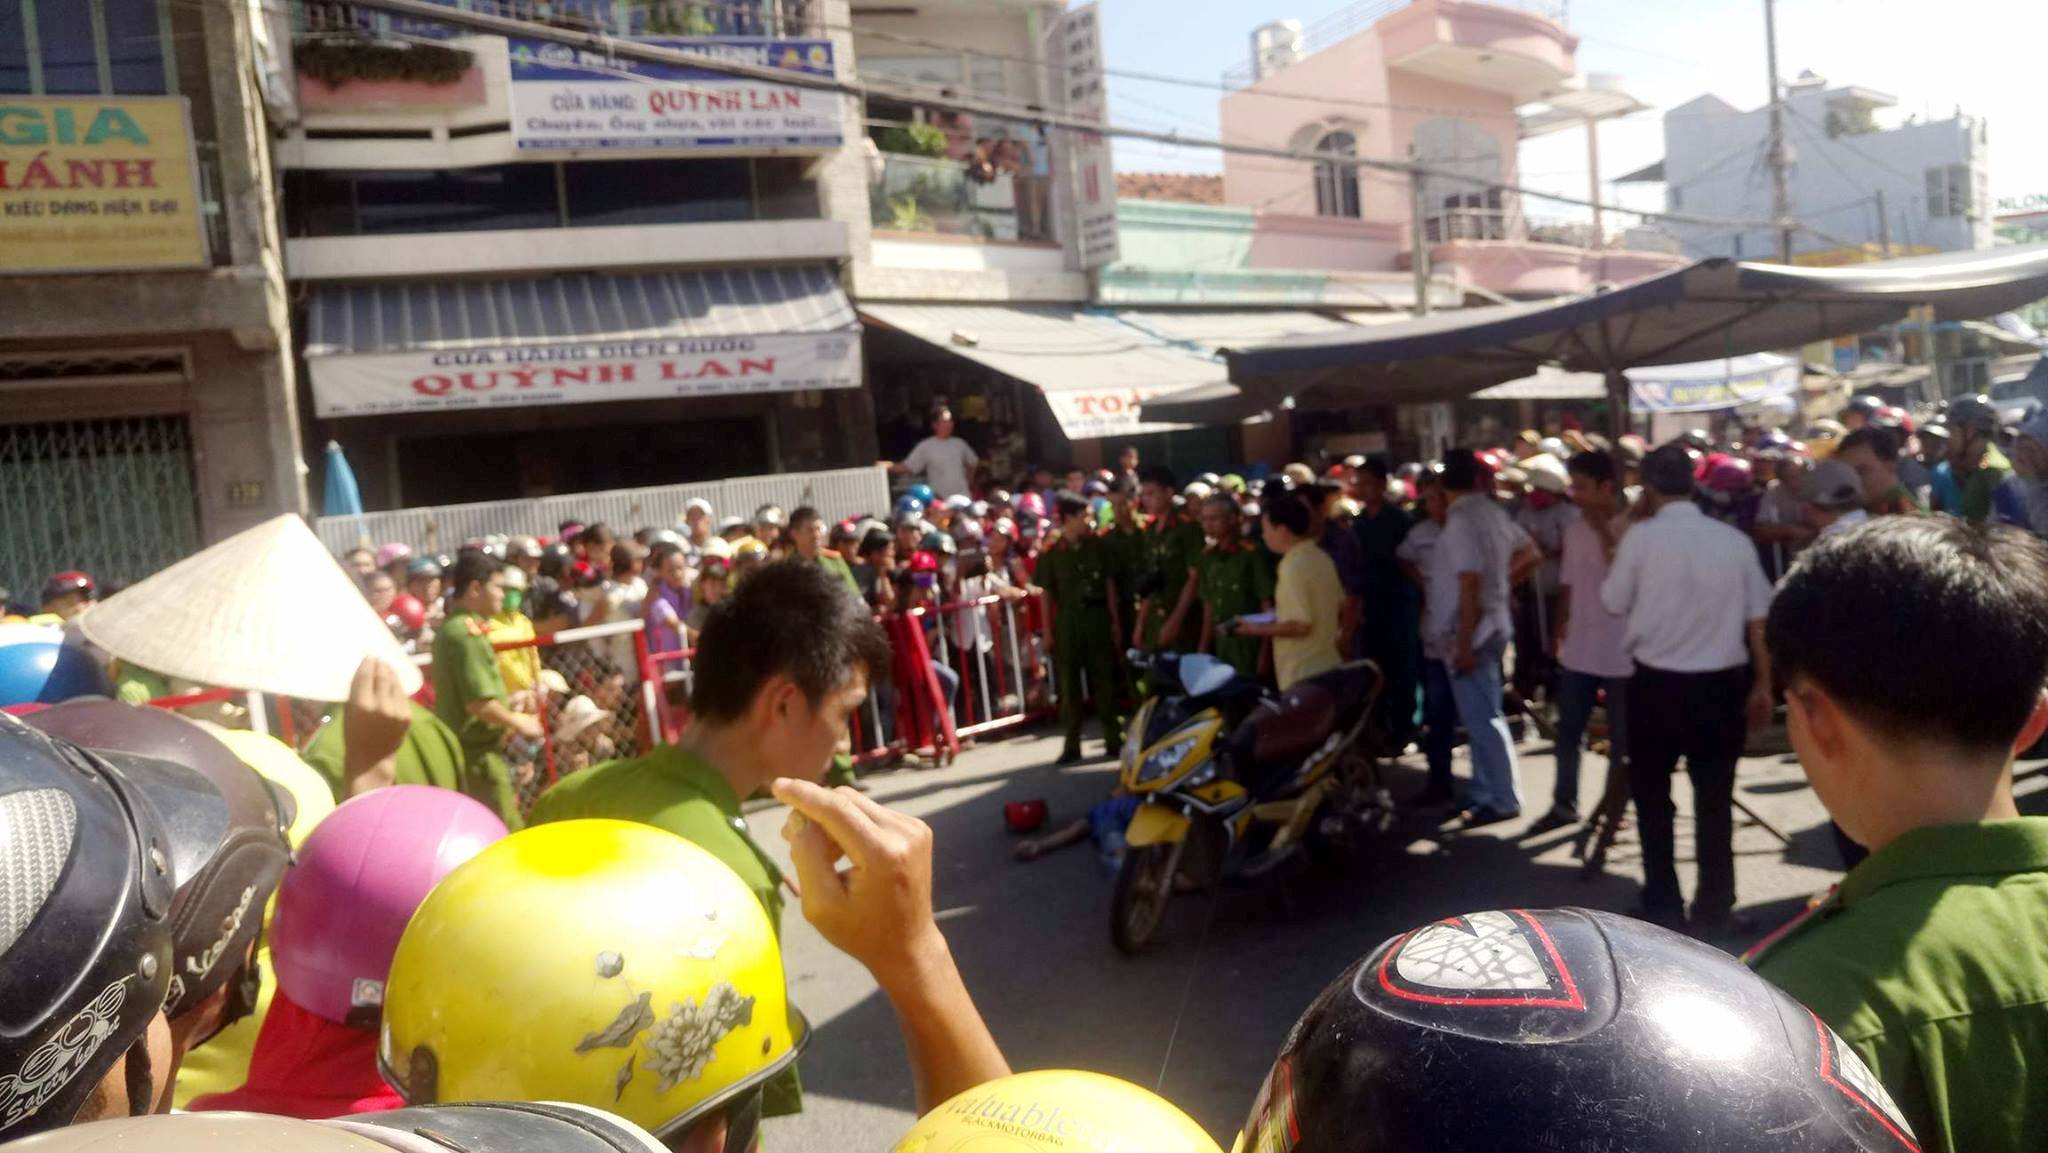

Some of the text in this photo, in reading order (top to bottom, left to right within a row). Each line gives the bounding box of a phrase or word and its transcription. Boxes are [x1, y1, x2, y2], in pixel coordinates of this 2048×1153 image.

[749, 88, 801, 112] LAN
[0, 106, 149, 145] GIA
[410, 357, 776, 396] QUỲNH LAN
[5, 1068, 70, 1125] Safety
